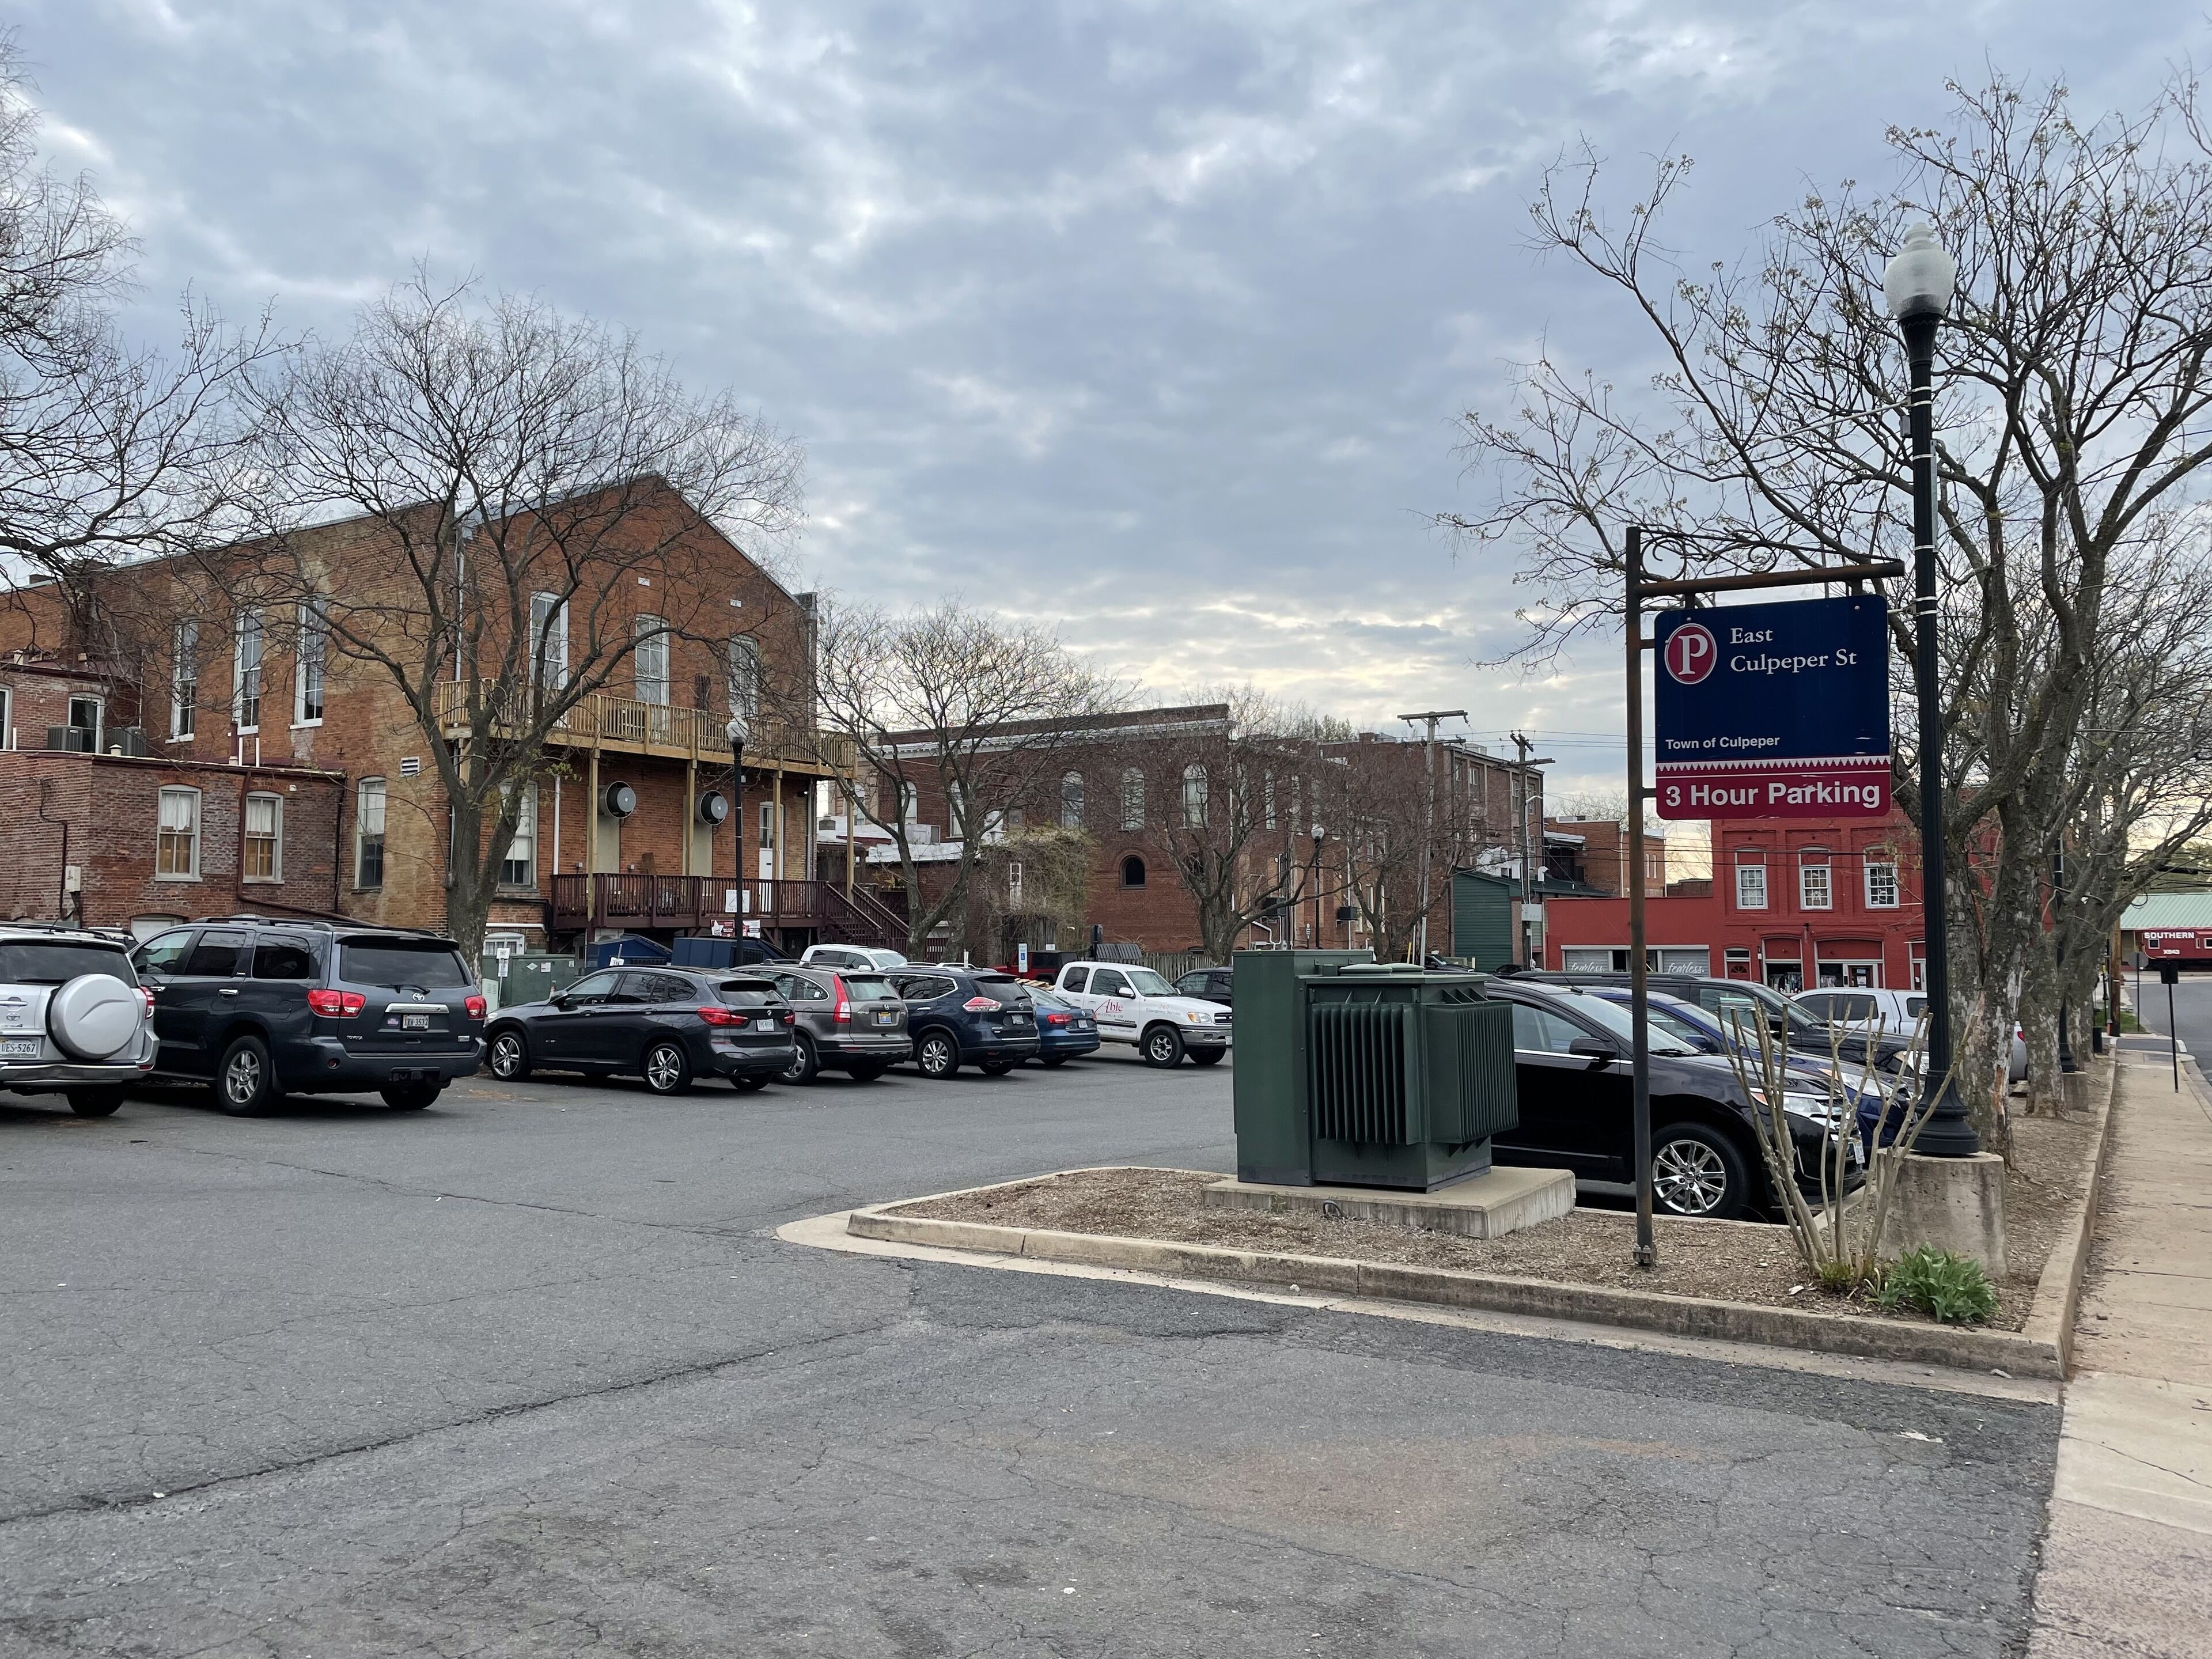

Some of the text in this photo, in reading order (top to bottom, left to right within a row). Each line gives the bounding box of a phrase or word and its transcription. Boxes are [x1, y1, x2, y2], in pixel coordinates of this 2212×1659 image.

[1730, 627, 1773, 644] East
[1677, 634, 1709, 675] P
[1730, 649, 1857, 675] Culpeper St
[1665, 736, 1781, 749] Town of Culpeper
[1665, 781, 1880, 809] 3 Hour Parking
[1094, 998, 1123, 1013] Able
[1, 1043, 36, 1052] UES-5267
